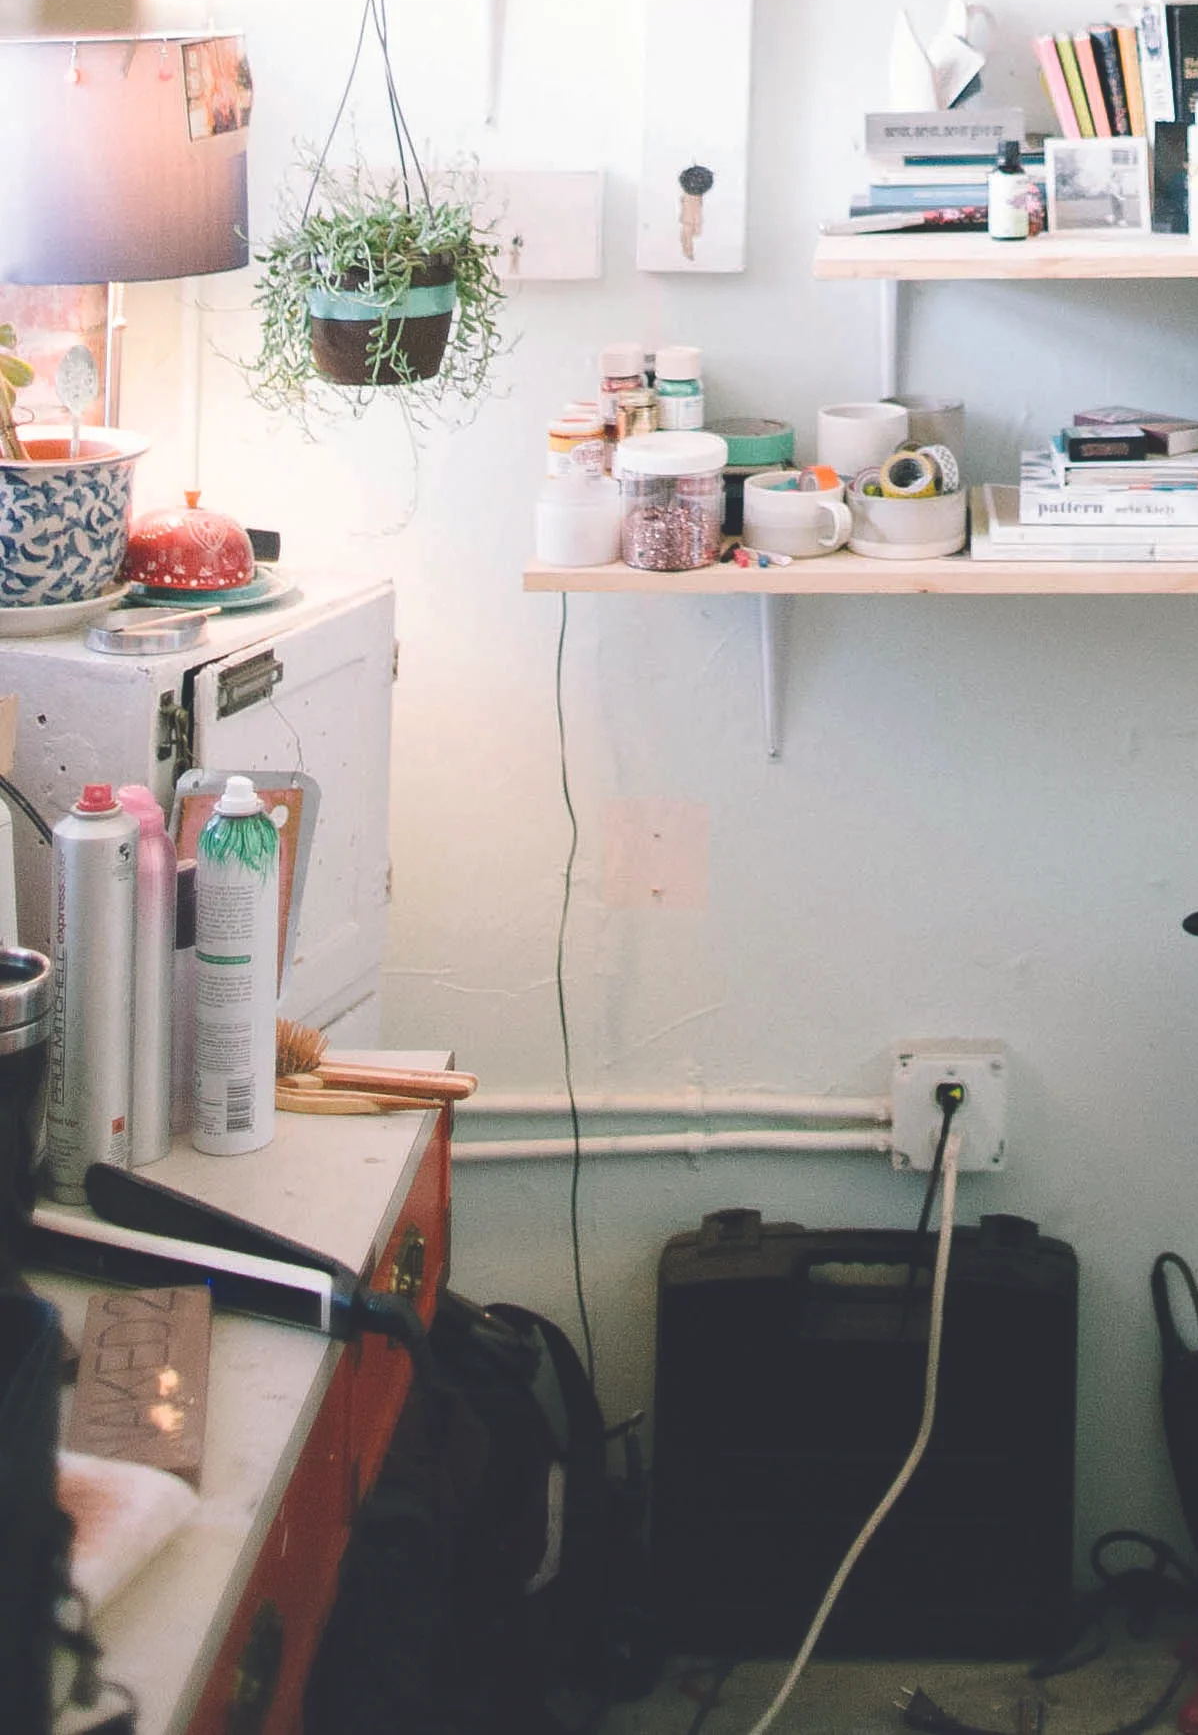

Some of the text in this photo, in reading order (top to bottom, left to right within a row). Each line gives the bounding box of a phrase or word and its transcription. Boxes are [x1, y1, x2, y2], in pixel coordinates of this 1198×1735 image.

[1037, 501, 1104, 518] pattern
[53, 946, 65, 1048] MITCHELL
[52, 1052, 64, 1105] PAUL
